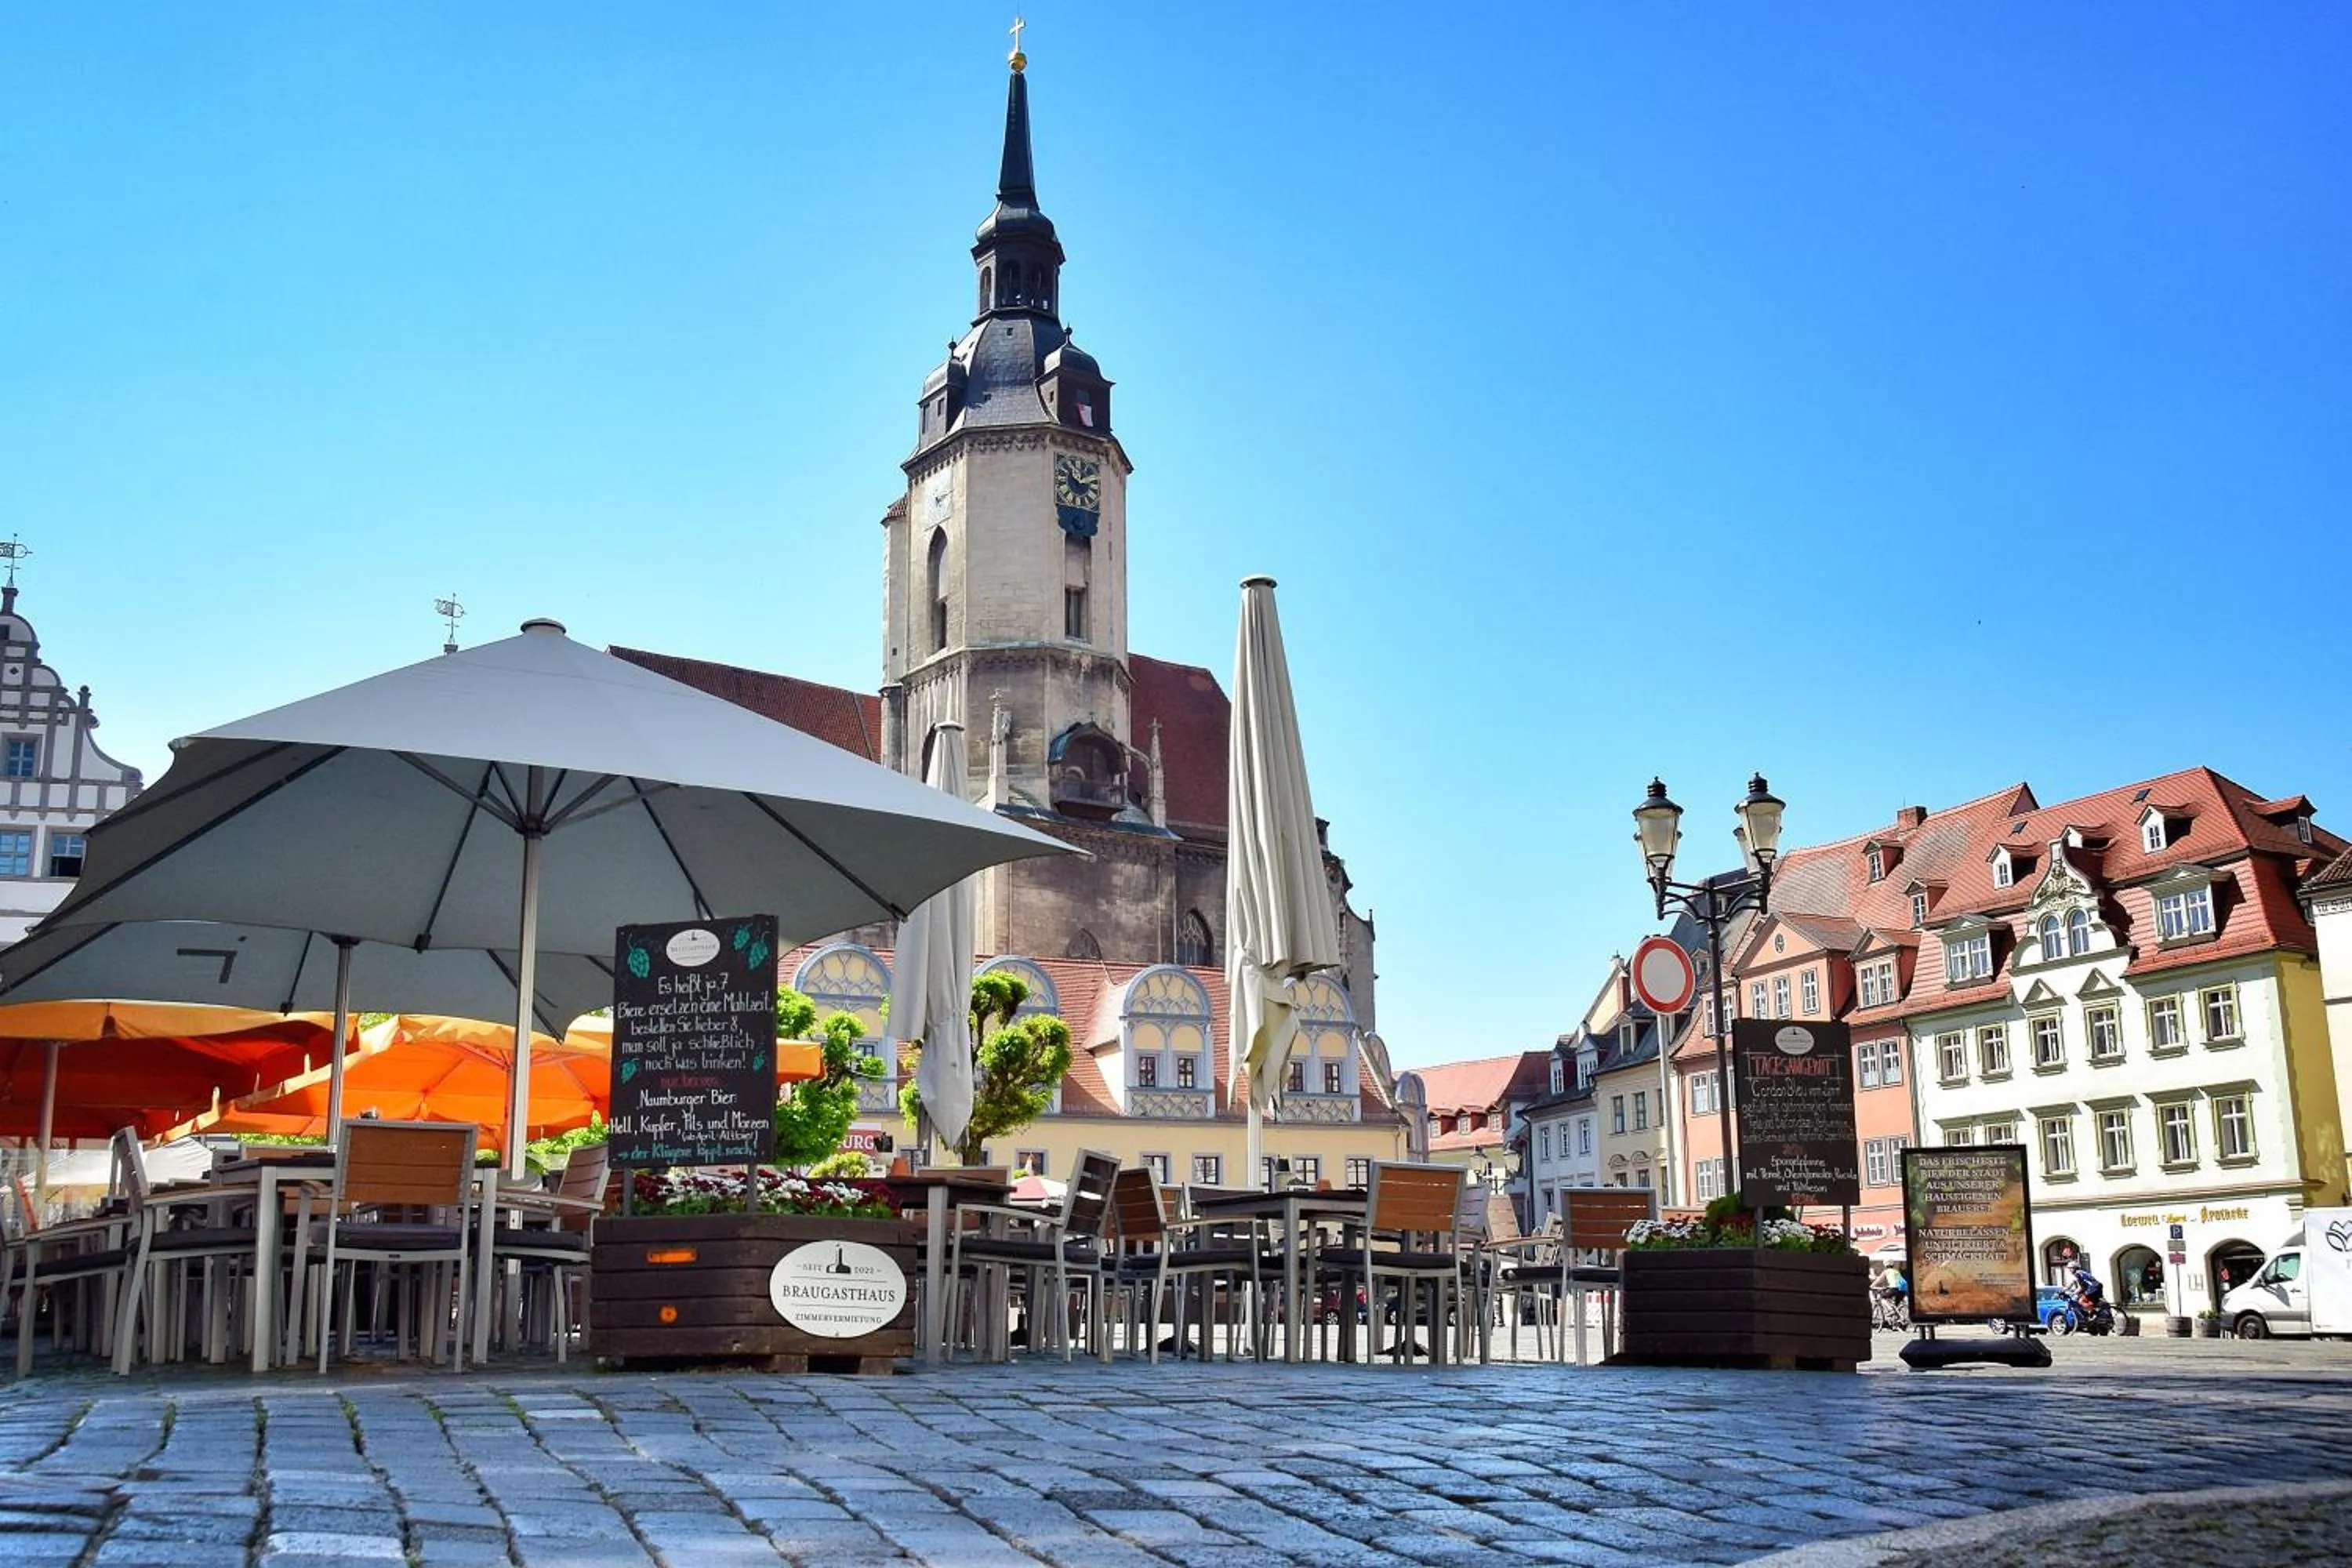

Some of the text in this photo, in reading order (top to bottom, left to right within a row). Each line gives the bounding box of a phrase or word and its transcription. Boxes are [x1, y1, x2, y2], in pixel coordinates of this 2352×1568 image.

[658, 976, 672, 995] Es
[719, 972, 729, 989] 7
[617, 1001, 647, 1018] Biere
[648, 997, 699, 1015] ersetzen
[631, 1017, 676, 1036] bestellen
[677, 1015, 691, 1031] Sie
[695, 1015, 728, 1032] lieber
[622, 1033, 755, 1058] man soll ja schließlich
[645, 1051, 747, 1071] noch was trinken!
[707, 1110, 728, 1129] und
[837, 1134, 875, 1150] URG
[1918, 1156, 2006, 1167] DAS FRISCHESTE
[1919, 1168, 2006, 1178] BIER DER STADT
[1926, 1181, 1999, 1190] AUS UNSERER
[1925, 1192, 2002, 1202] HAUSEIGENEN
[1936, 1204, 1992, 1213] BRAUEREI
[1925, 1240, 1998, 1250] UNFILTRIERT
[1925, 1252, 2007, 1261] SCHMACKHAFT
[783, 1285, 896, 1302] BRAUGASTHAUS
